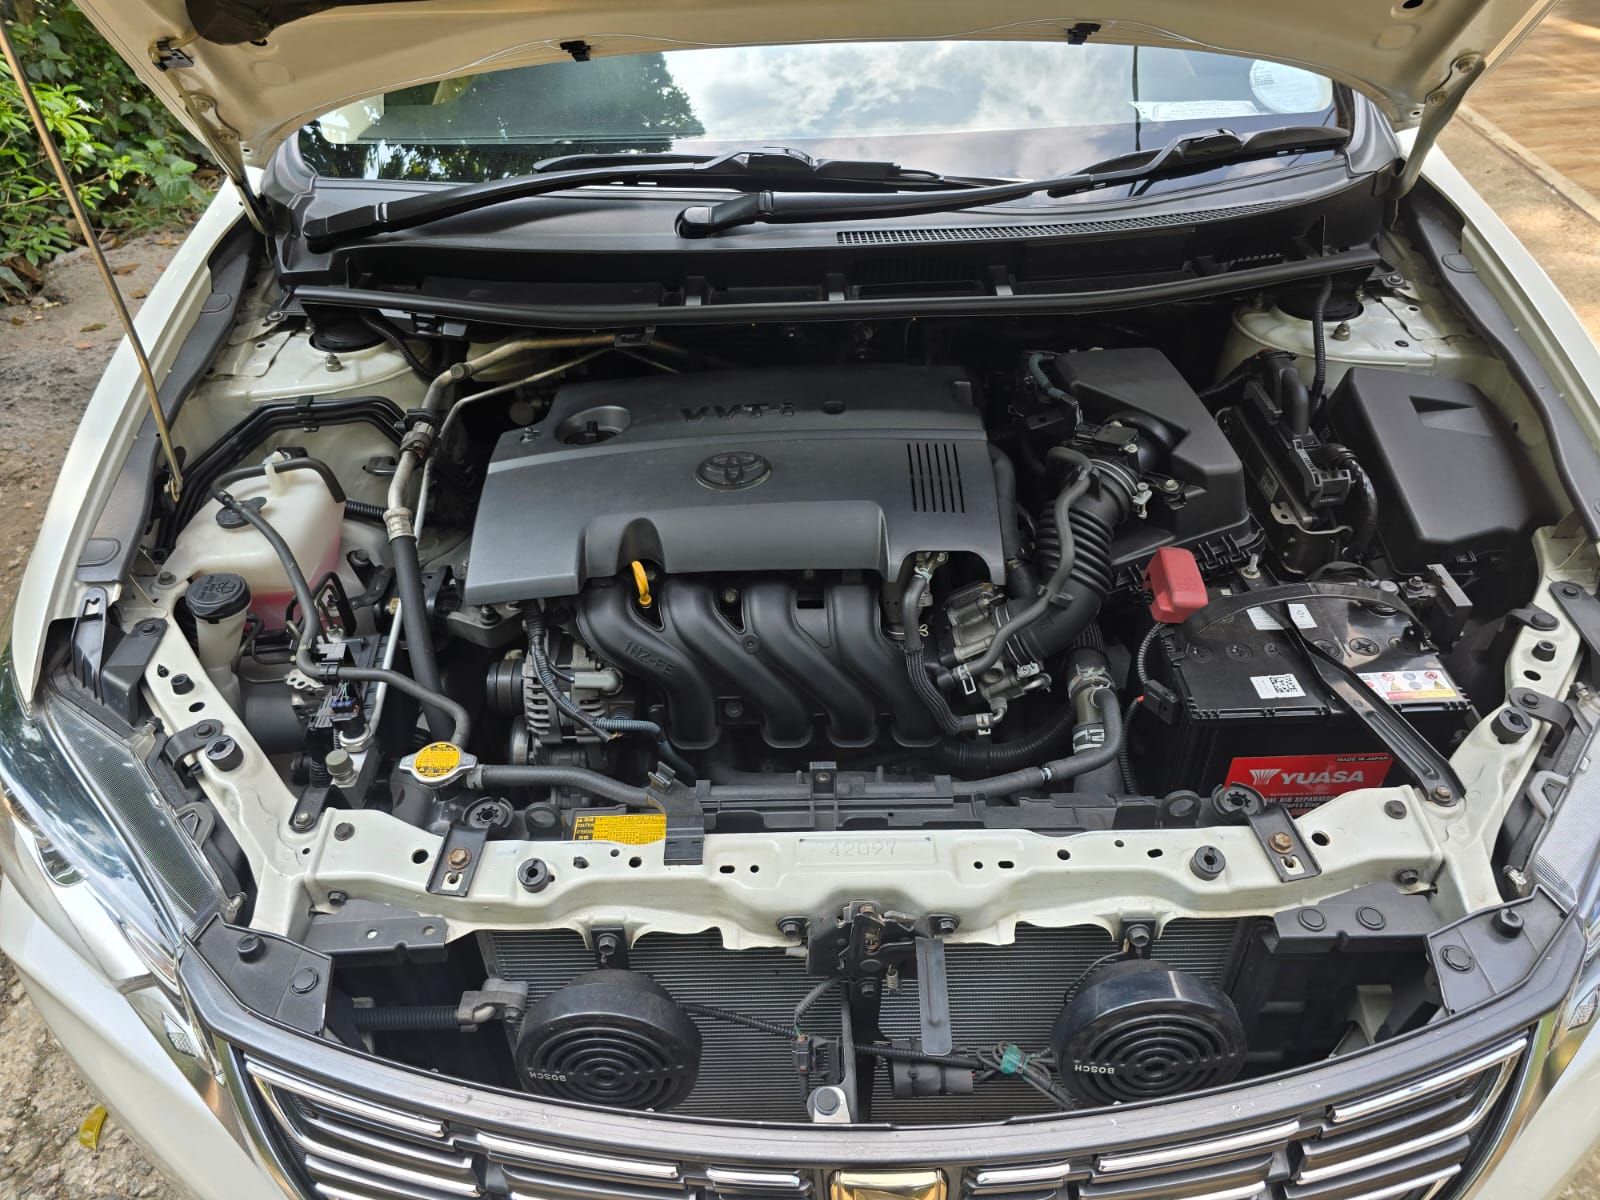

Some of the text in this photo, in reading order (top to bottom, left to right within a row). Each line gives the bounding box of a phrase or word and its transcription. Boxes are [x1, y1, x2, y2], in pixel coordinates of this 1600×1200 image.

[1281, 770, 1364, 785] YUASA
[830, 838, 897, 857] 42097
[1074, 1064, 1115, 1074] BOSCH
[529, 1071, 567, 1081] BOSCH
